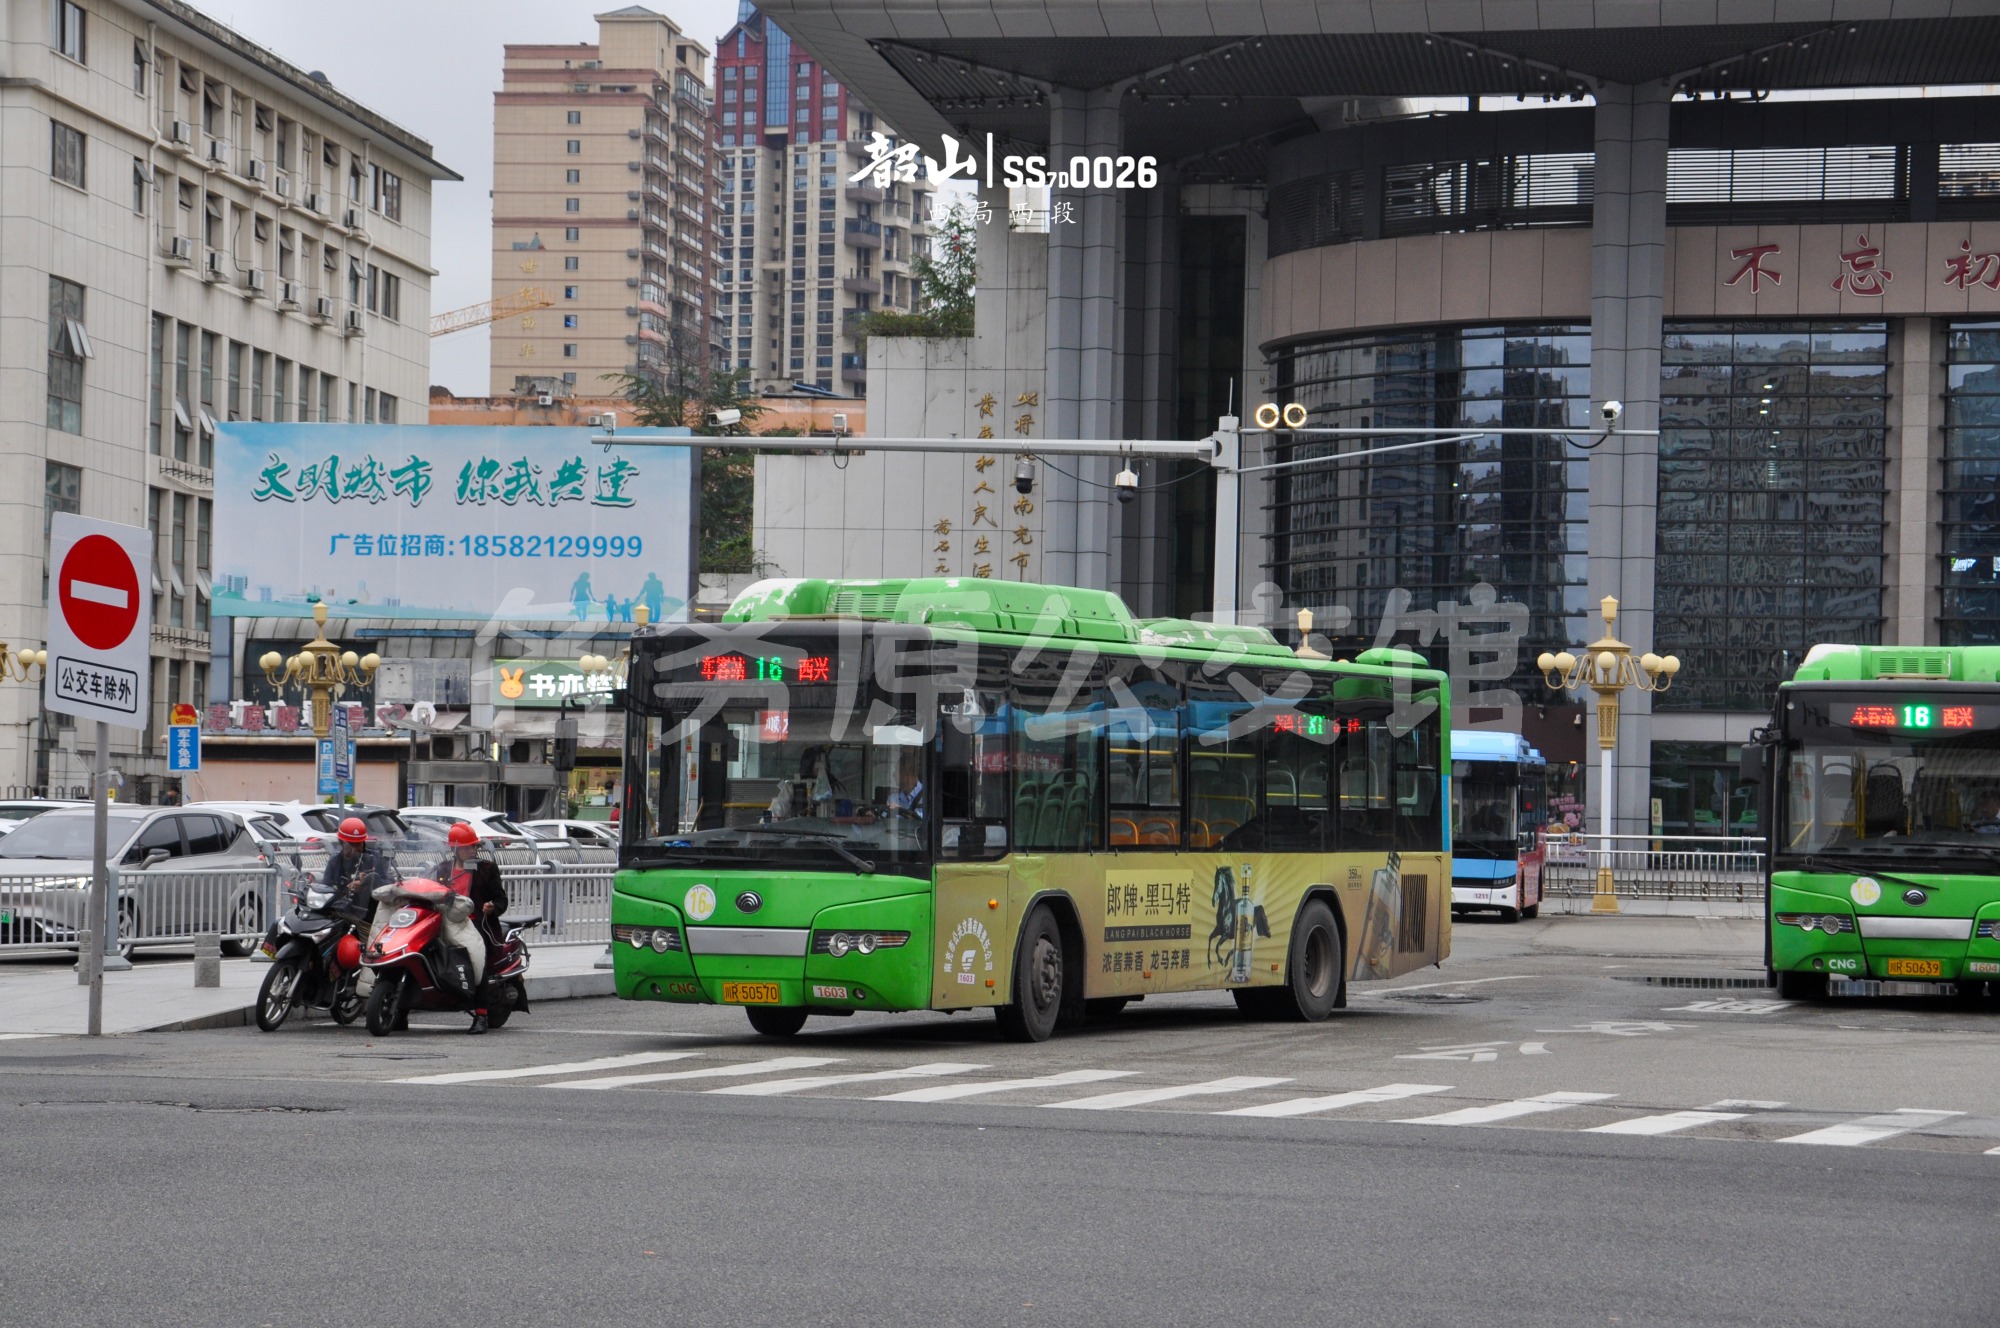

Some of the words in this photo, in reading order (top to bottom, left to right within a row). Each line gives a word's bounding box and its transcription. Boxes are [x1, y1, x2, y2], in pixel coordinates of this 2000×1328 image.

[1724, 234, 2000, 296] 不忘初
[252, 453, 434, 507] 文明城市
[455, 454, 641, 508] 你我共建
[329, 533, 643, 558] 广告位招商:18582129999
[756, 656, 783, 682] 16
[798, 657, 830, 681] 西兴
[61, 666, 132, 704] 公交车除外
[528, 673, 628, 698] 书亦烧
[1903, 705, 1930, 727] 16
[1942, 706, 1974, 728] 西兴
[177, 729, 191, 768] 军车免费
[1150, 948, 1190, 970] 龙马奔腾
[1828, 959, 1857, 969] CNG
[669, 982, 697, 994] CNG
[818, 986, 846, 998] 1603
